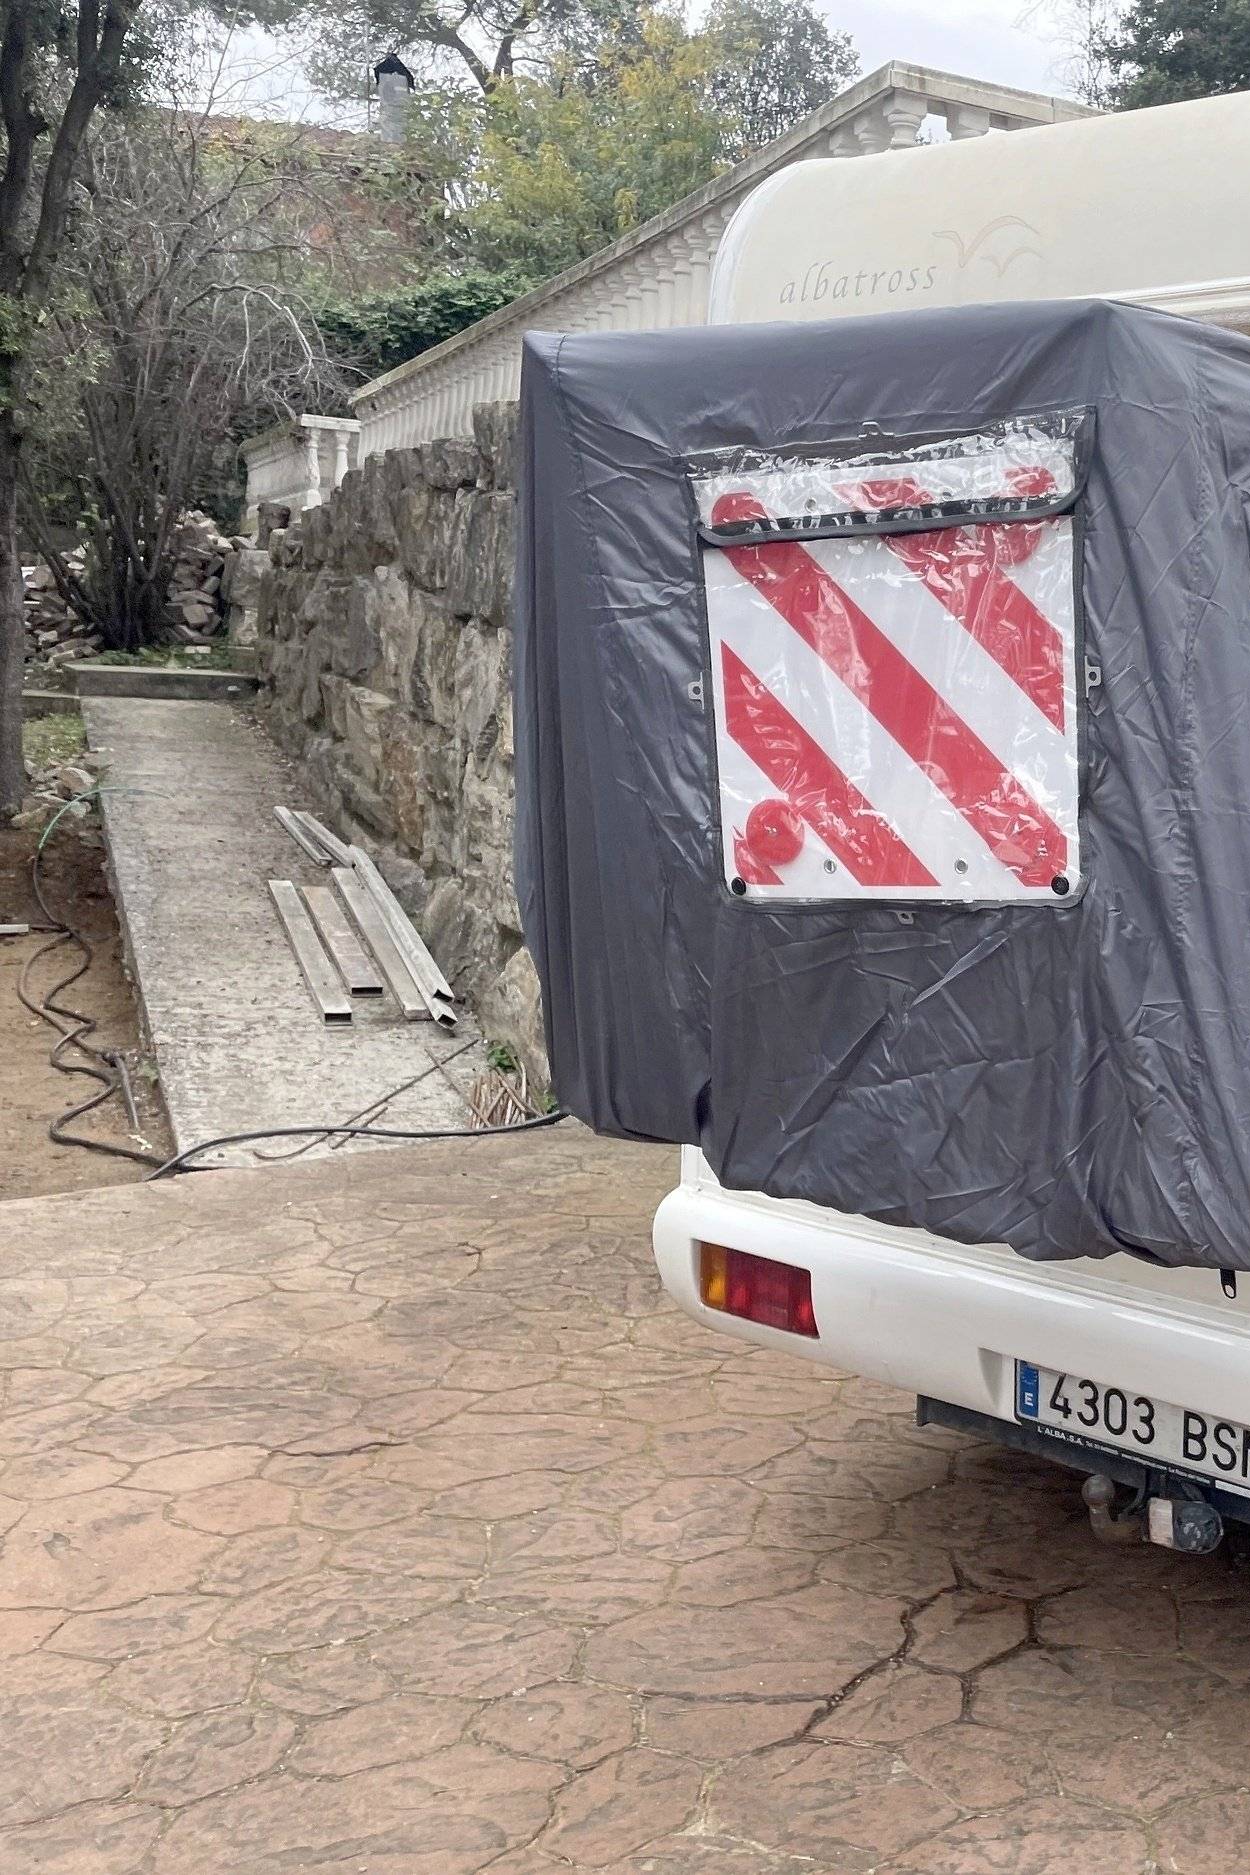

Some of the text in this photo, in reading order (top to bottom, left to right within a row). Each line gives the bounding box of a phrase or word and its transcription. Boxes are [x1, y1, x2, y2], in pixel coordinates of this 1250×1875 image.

[779, 260, 938, 304] albatross
[1024, 1391, 1034, 1407] E
[1049, 1373, 1155, 1445] 4303
